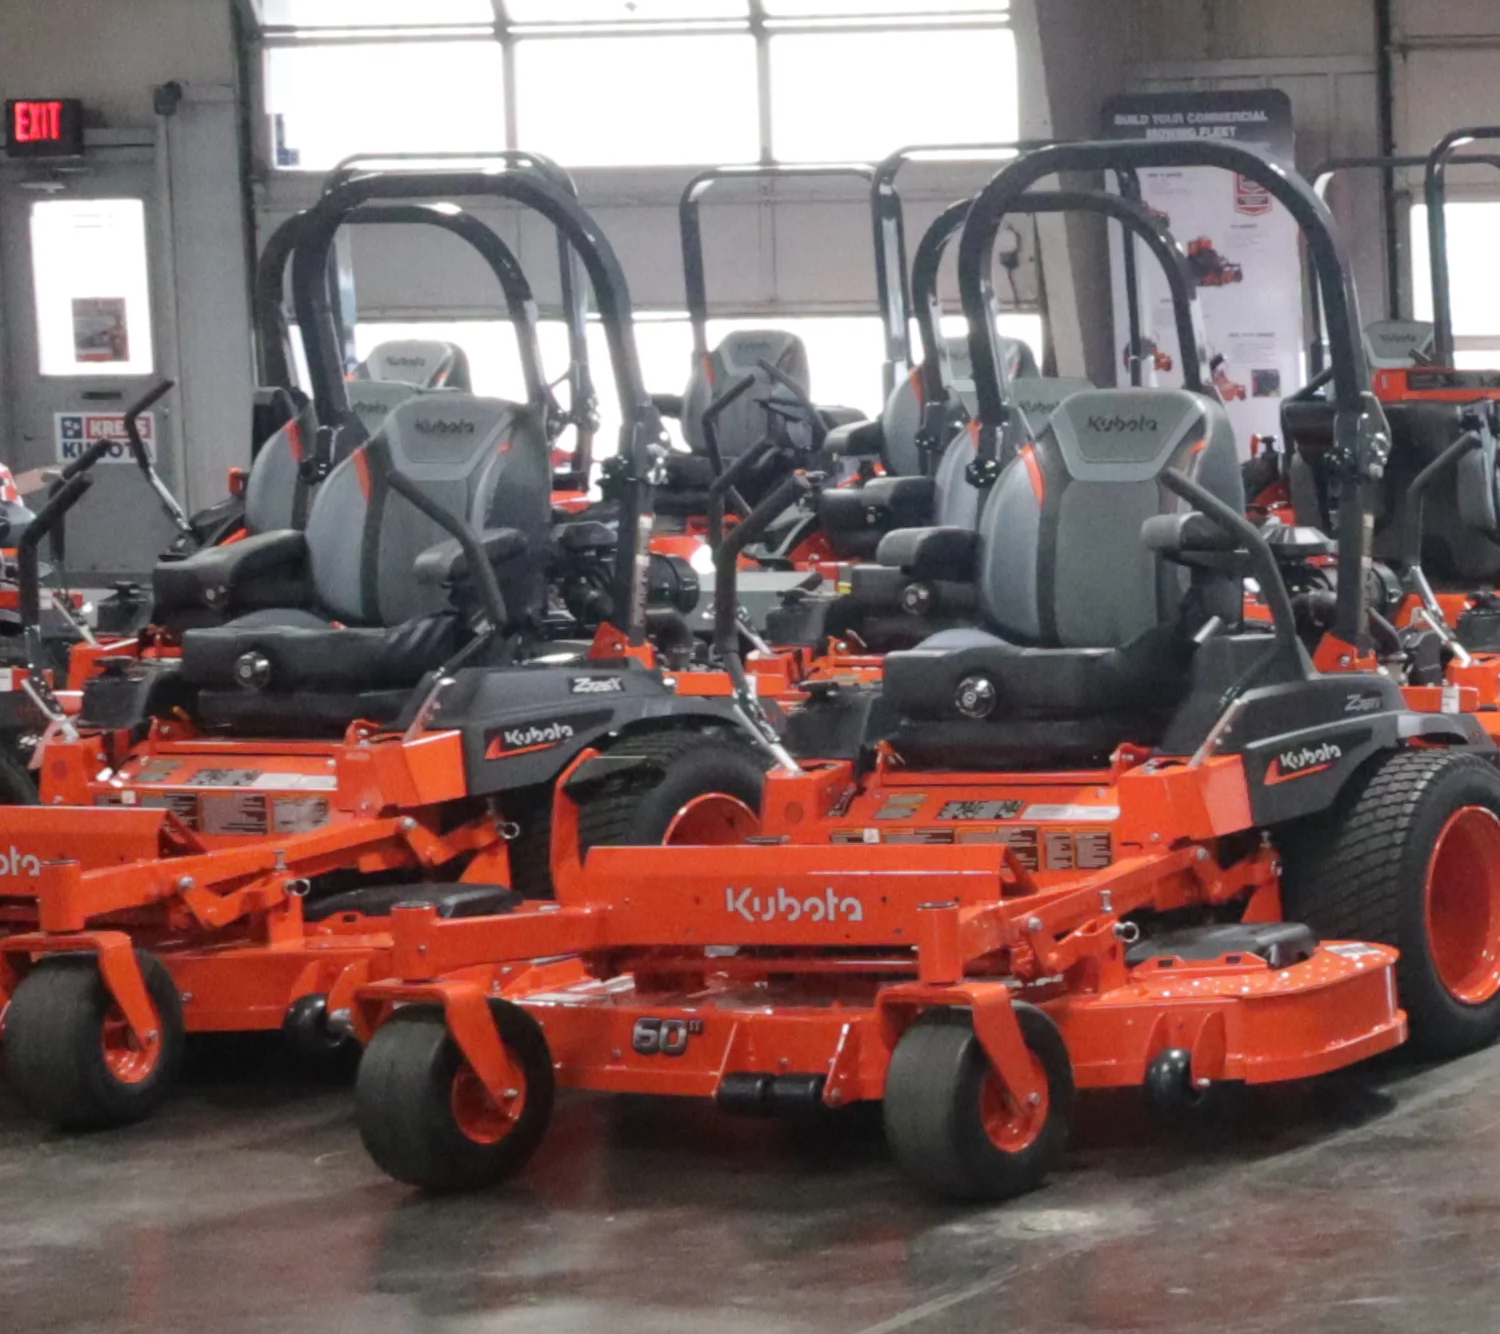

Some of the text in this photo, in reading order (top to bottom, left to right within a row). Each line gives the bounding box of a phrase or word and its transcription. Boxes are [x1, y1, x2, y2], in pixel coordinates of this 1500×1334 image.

[14, 101, 62, 142] EXIT
[1113, 110, 1268, 126] BUILD YOUR COMMERCIAL
[90, 418, 148, 437] KRES
[413, 418, 475, 434] Kubota
[1086, 415, 1156, 432] Kubota
[503, 722, 574, 746] Kubota
[1279, 742, 1341, 769] Kubota
[725, 886, 864, 923] Kubota
